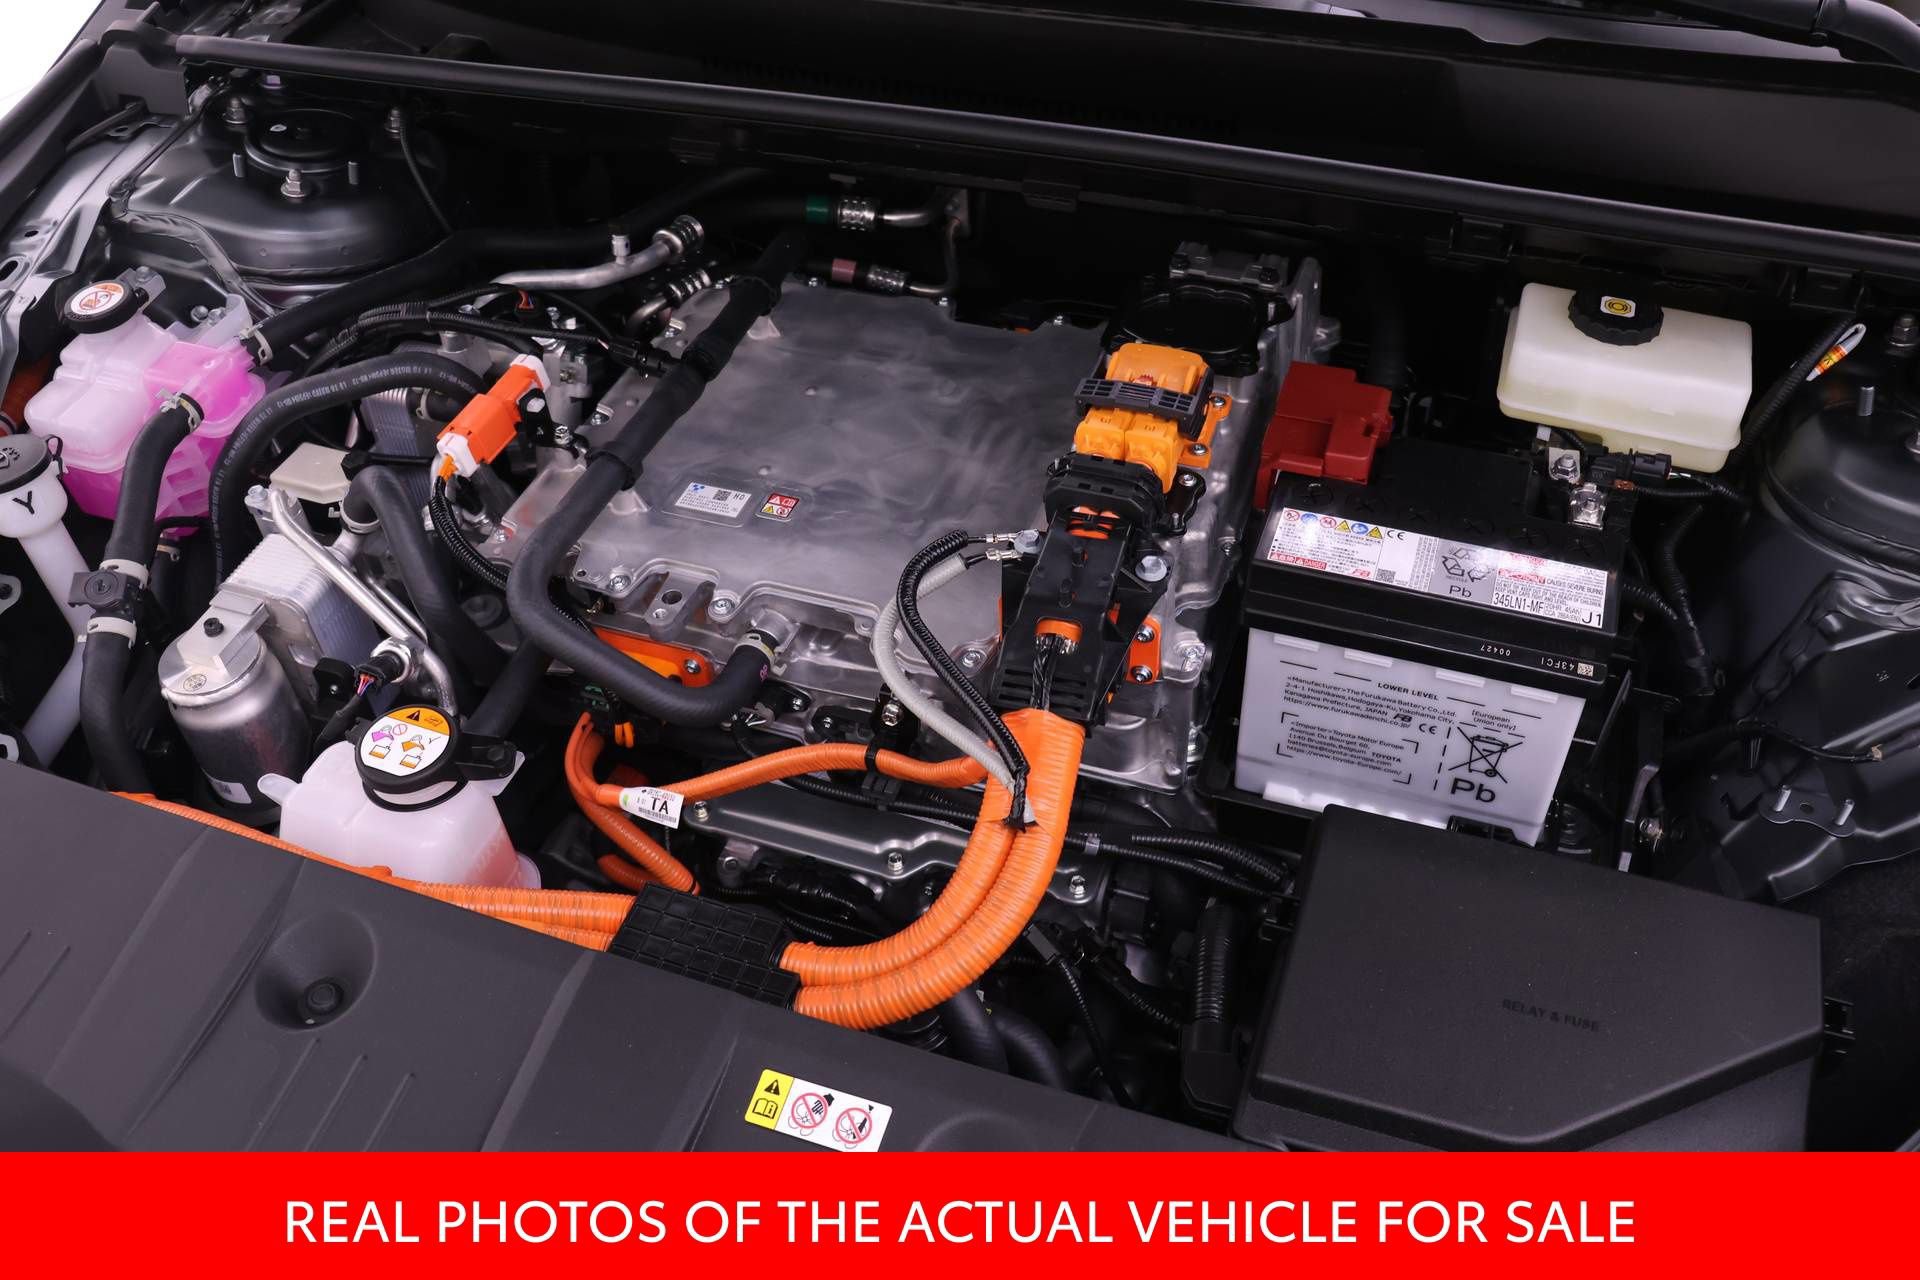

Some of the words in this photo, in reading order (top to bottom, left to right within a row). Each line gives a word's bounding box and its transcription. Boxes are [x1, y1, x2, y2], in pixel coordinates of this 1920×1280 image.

[1449, 585, 1472, 598] Pb
[1492, 591, 1544, 614] 345LN1-MF
[1581, 610, 1602, 626] J1
[1480, 645, 1511, 656] 00427
[1285, 682, 1304, 690] 2-4-1
[1377, 682, 1408, 693] LOWER
[1411, 689, 1438, 700] LEVEL
[1365, 707, 1388, 715] JAPAN
[1397, 699, 1426, 710] Battery
[1371, 752, 1401, 762] TOYOTA
[1450, 778, 1496, 803] Pb
[651, 796, 669, 814] TA
[1502, 999, 1546, 1017] RELAY
[1564, 1014, 1599, 1032] FUSE
